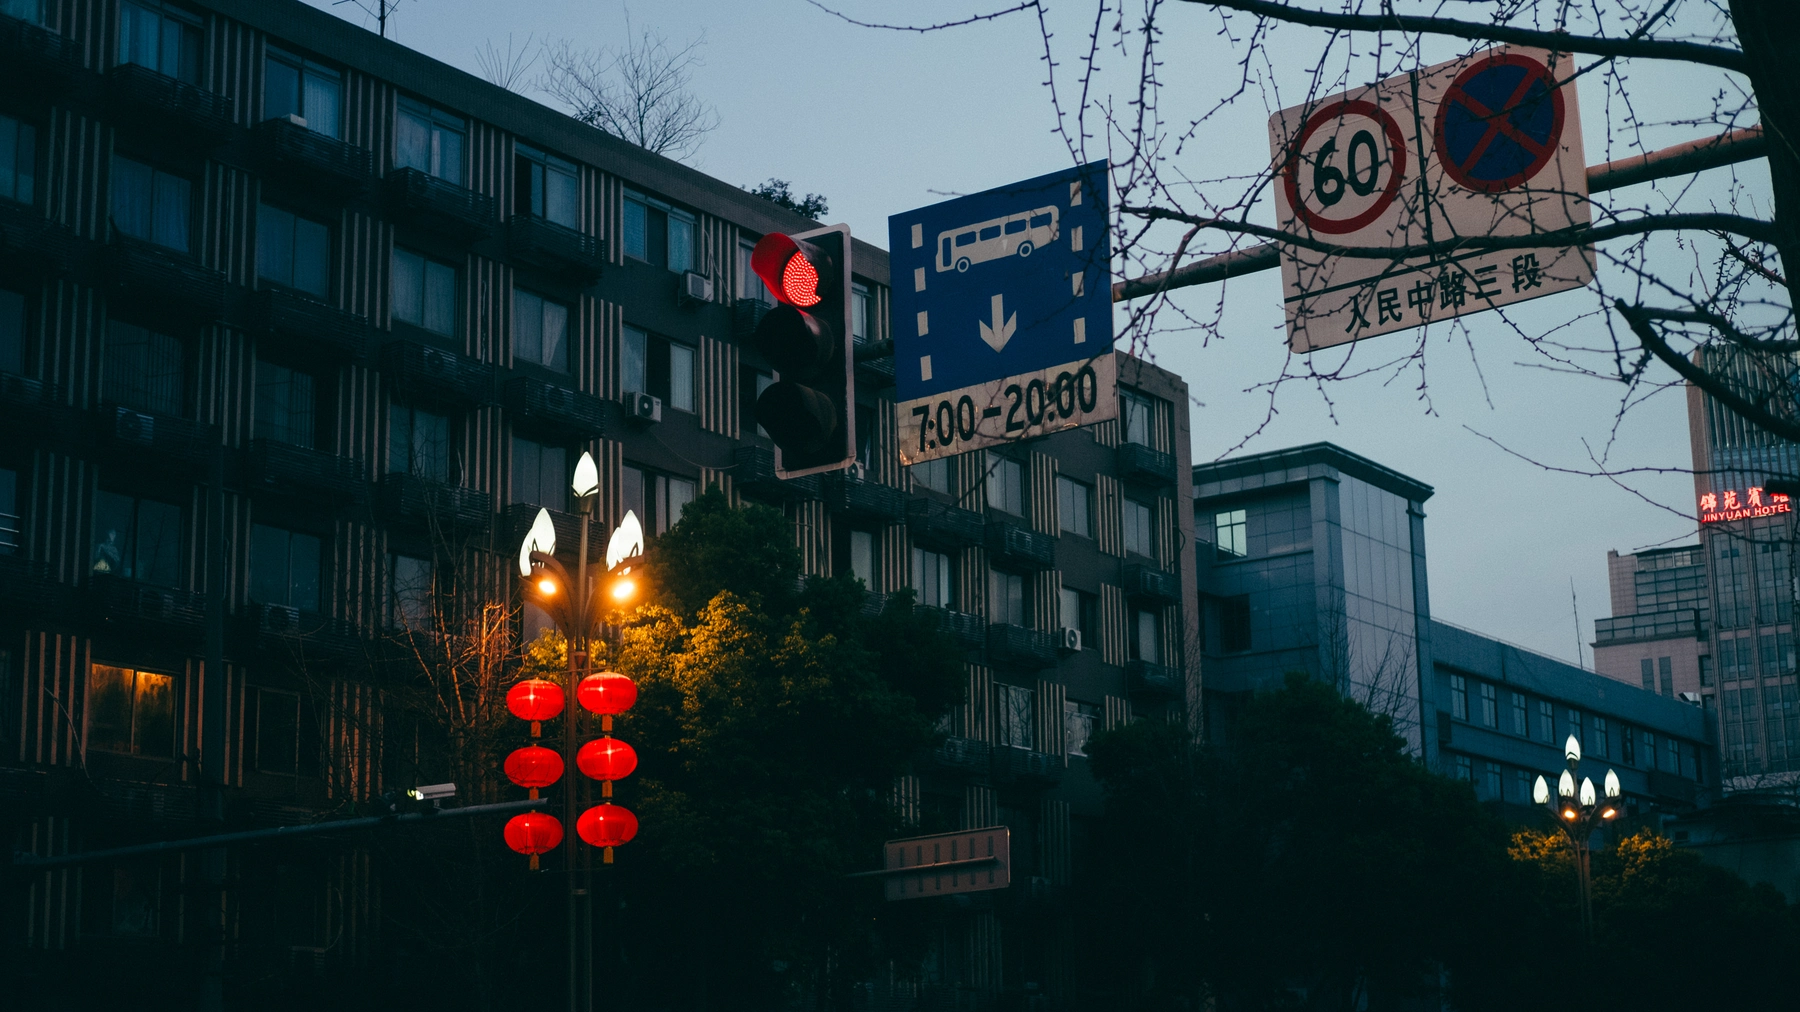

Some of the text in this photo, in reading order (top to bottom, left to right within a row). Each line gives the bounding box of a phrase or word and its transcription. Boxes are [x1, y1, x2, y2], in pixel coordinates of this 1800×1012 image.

[1314, 130, 1378, 205] 60
[1345, 253, 1542, 333] 人民中路三段
[1702, 503, 1792, 522] JINYUAN HOTEL
